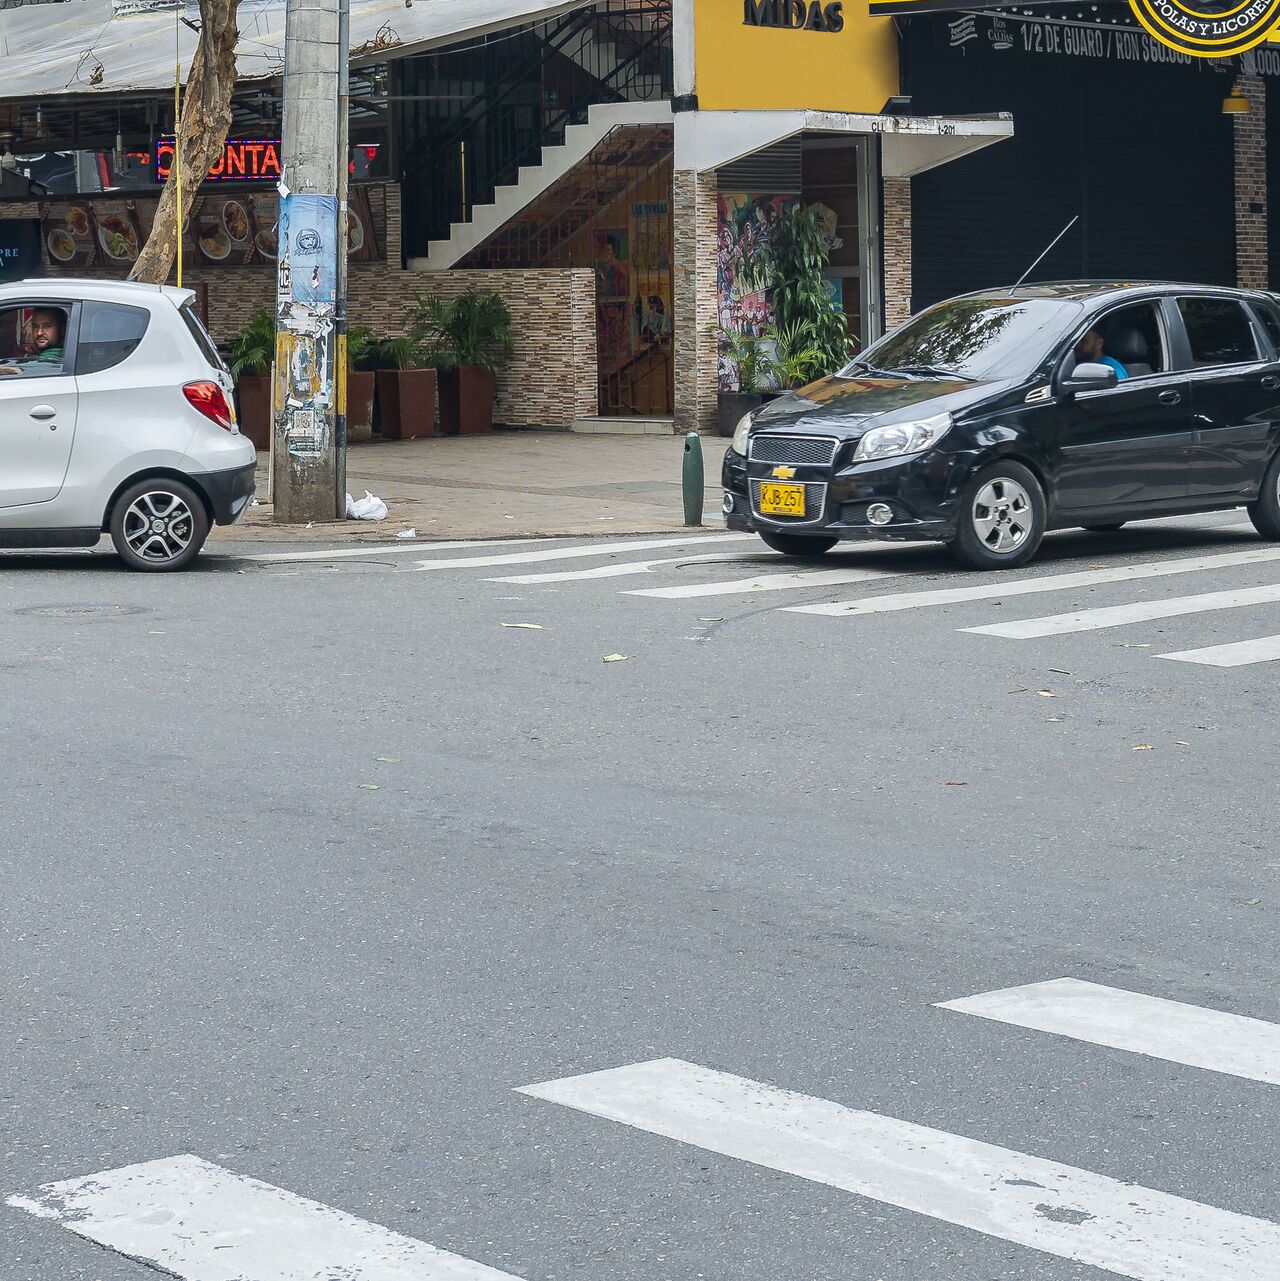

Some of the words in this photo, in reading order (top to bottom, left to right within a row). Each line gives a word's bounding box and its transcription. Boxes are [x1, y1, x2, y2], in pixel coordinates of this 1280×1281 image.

[1020, 23, 1044, 52] 1/2
[1045, 24, 1062, 54] DE
[1064, 27, 1103, 58] GUARO
[1116, 32, 1140, 61] RON
[1199, 23, 1210, 36] Y
